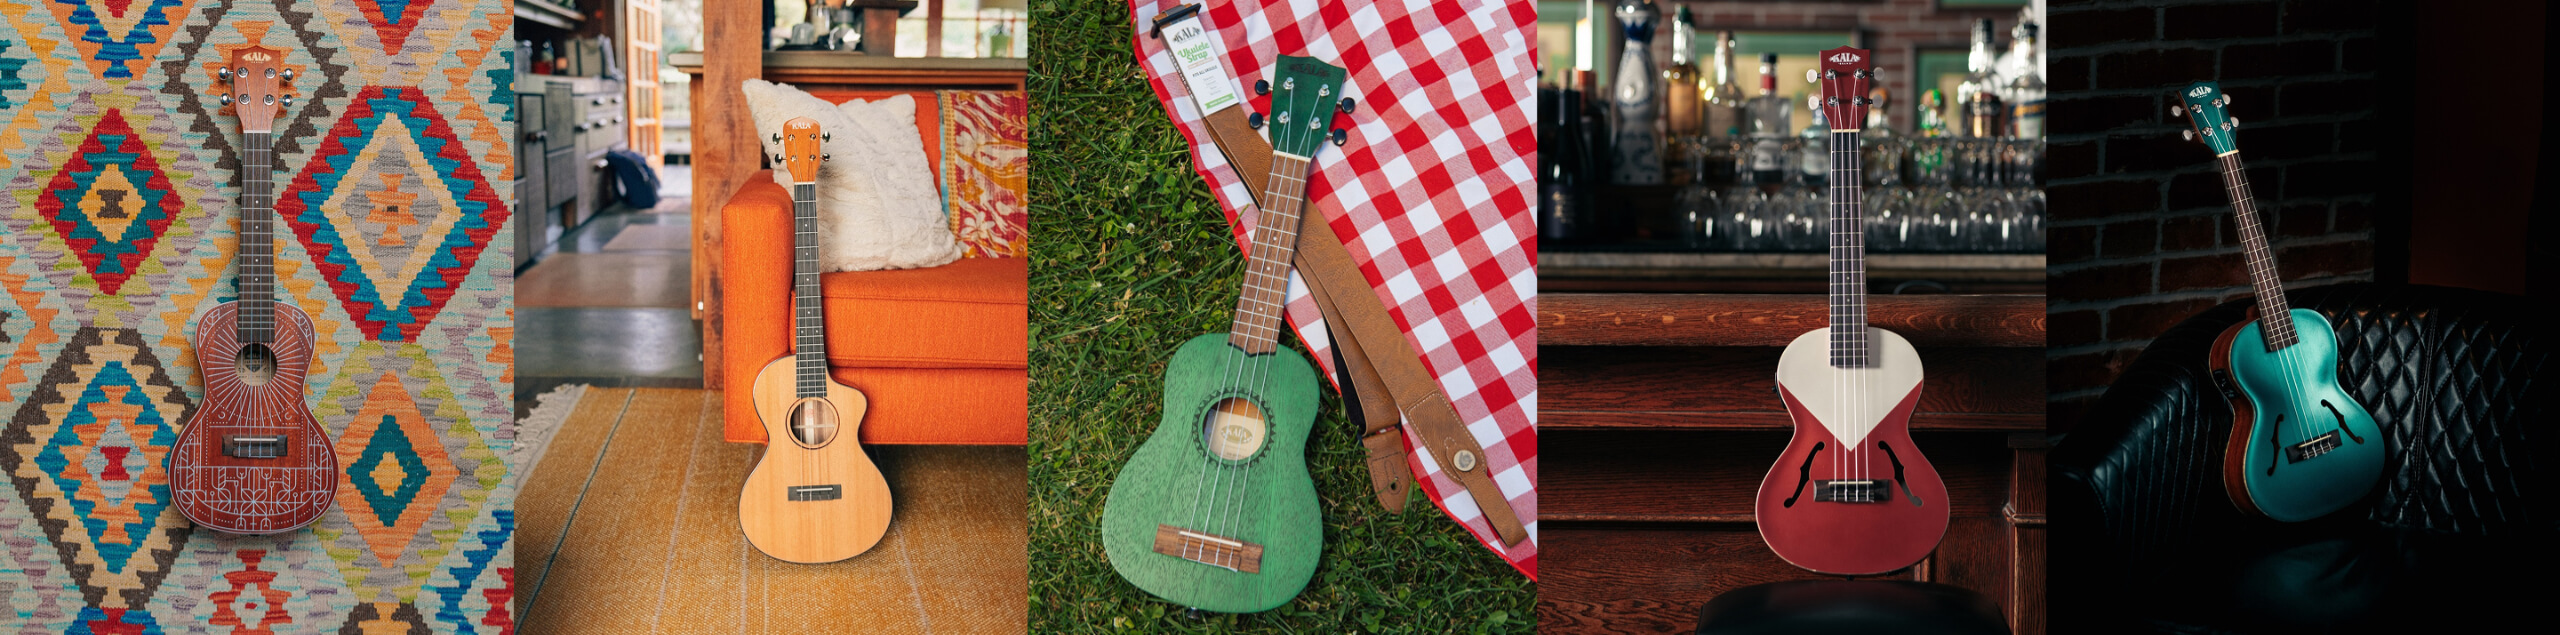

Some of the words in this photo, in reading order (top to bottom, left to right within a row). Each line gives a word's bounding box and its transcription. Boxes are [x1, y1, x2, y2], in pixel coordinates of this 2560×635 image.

[1173, 26, 1201, 42] KALA
[1177, 42, 1210, 58] Ukulele
[242, 52, 272, 61] KALA
[1186, 51, 1208, 63] Strap
[1829, 53, 1861, 62] KALA
[1289, 63, 1331, 77] KALA
[2188, 86, 2212, 97] KALA
